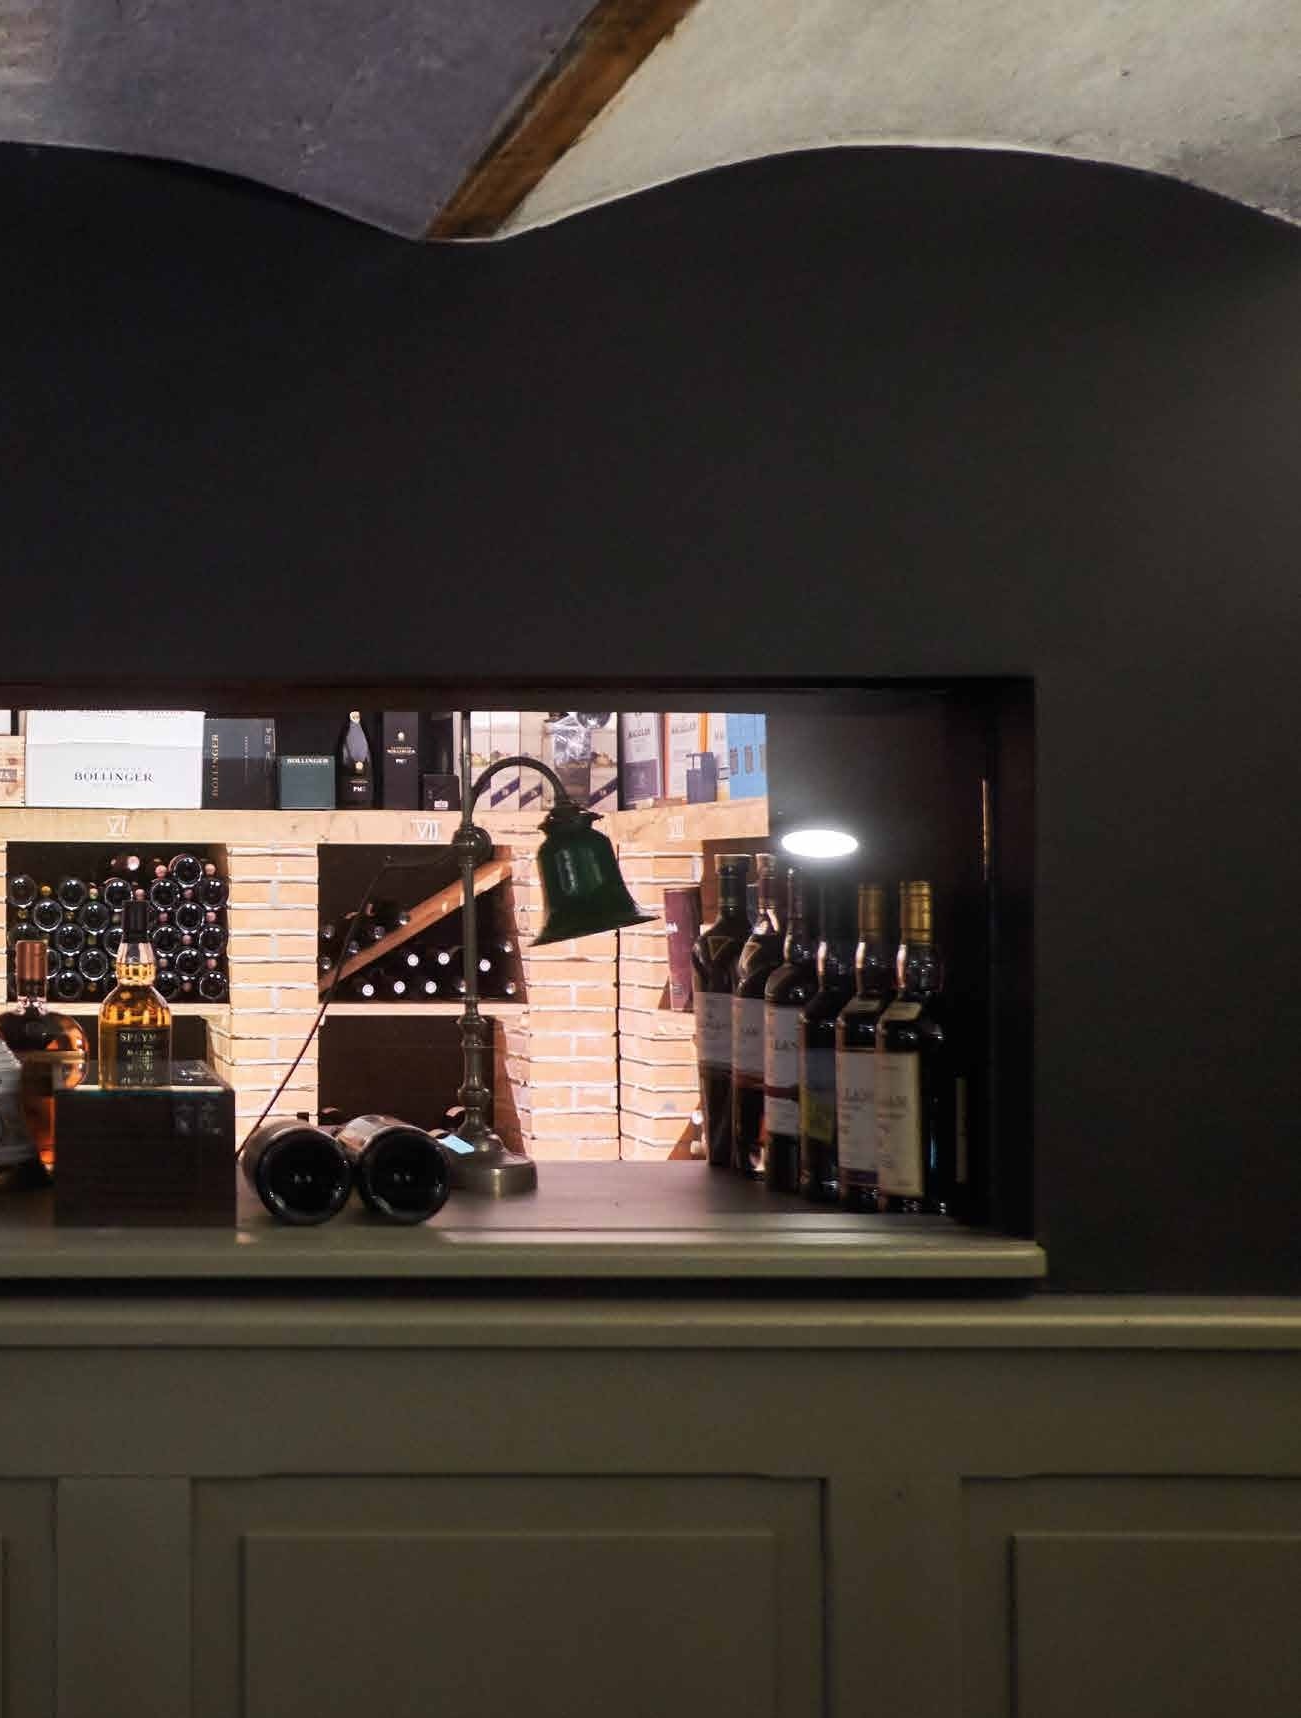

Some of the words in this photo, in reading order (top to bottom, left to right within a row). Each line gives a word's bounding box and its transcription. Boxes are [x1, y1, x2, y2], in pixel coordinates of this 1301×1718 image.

[74, 771, 155, 784] BOLLINGER
[210, 733, 220, 800] BOLLINGER
[410, 818, 441, 841] VII
